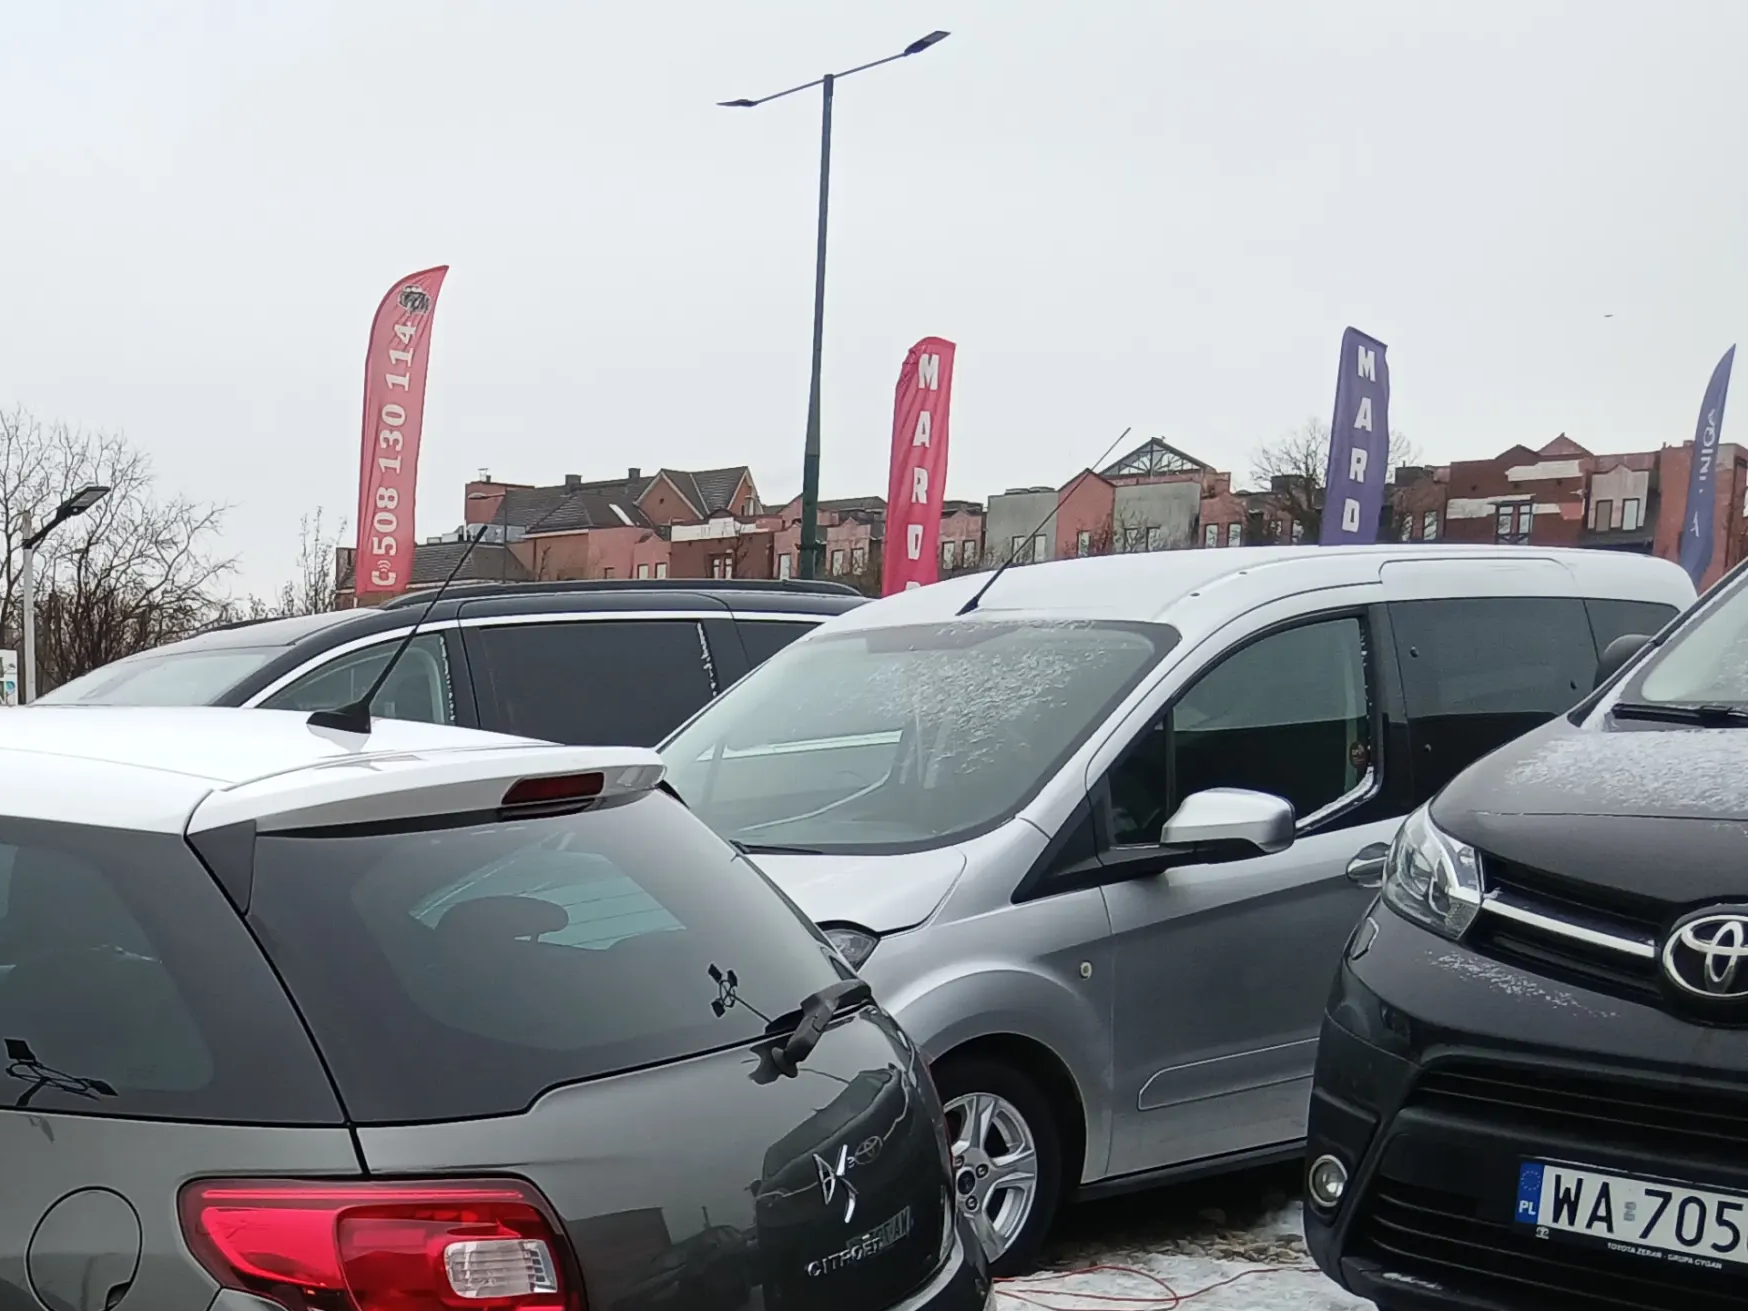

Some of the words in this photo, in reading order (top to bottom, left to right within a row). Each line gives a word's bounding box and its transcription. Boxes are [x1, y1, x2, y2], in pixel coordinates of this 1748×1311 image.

[384, 322, 417, 392] 114
[378, 402, 407, 475] 130
[1341, 345, 1376, 533] MARD
[371, 486, 400, 557] 508
[1518, 1199, 1537, 1216] PL
[1552, 1174, 1615, 1234] WA
[1638, 1187, 1748, 1255] 705
[1607, 1241, 1636, 1254] TOYOTA
